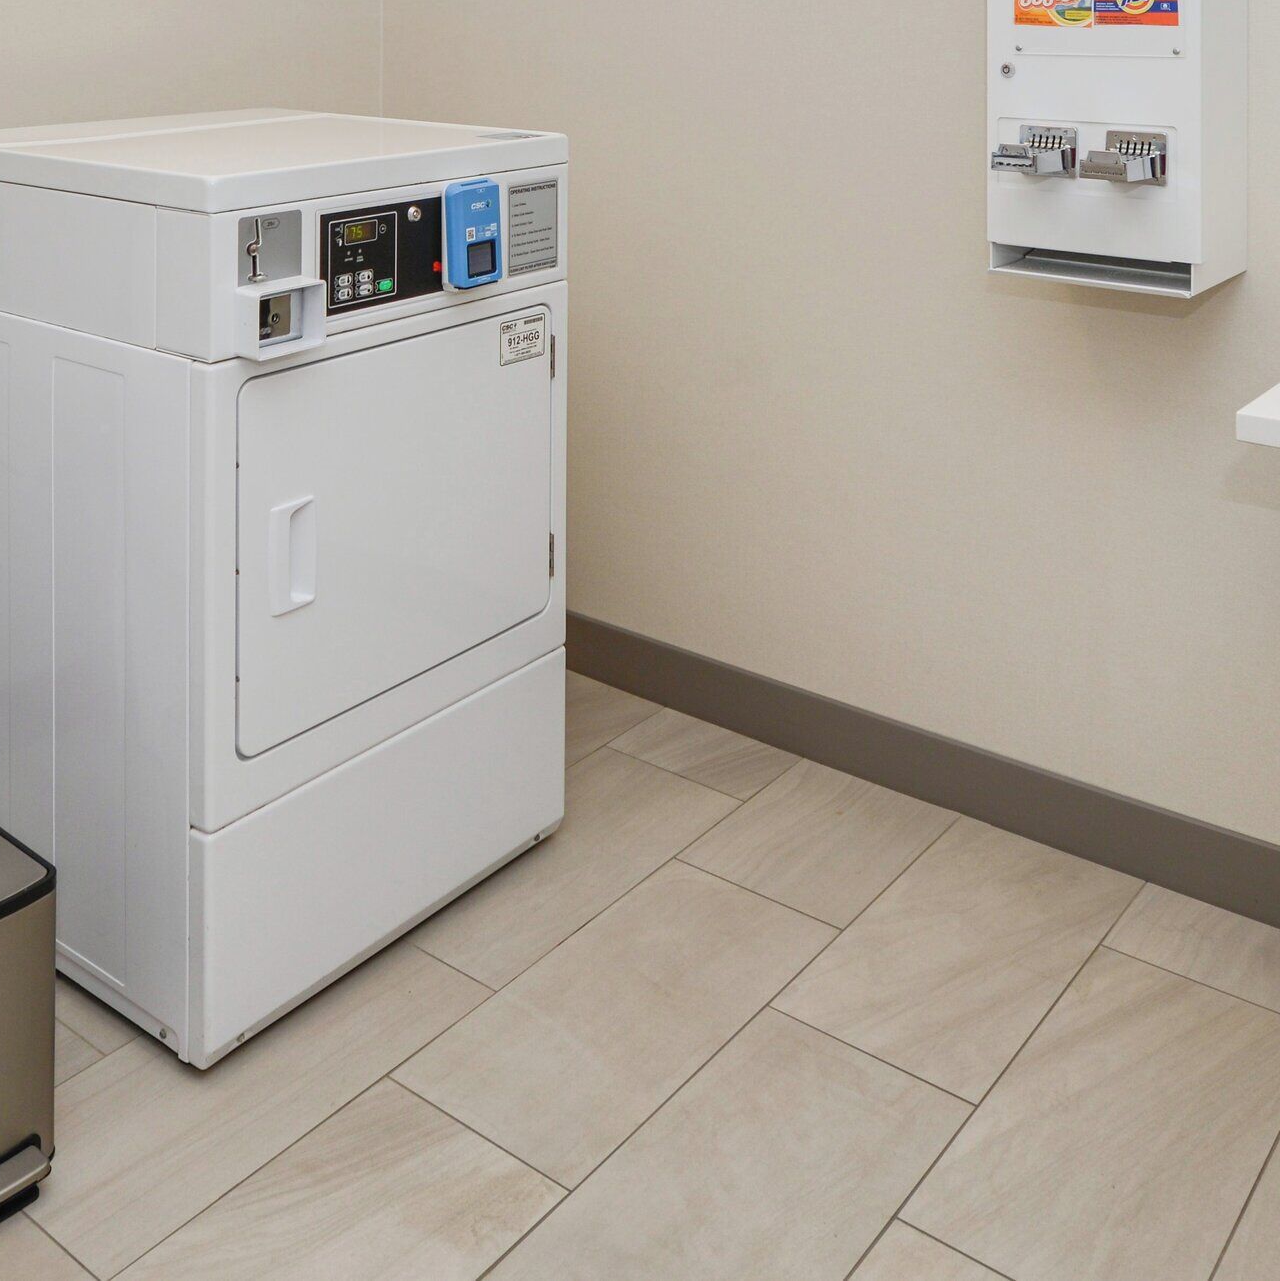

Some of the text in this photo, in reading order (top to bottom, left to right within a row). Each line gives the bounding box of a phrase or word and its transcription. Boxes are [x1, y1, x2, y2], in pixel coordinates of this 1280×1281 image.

[510, 182, 556, 196] OPERATING INSTRUCTIONS
[471, 201, 485, 210] CSC
[502, 323, 513, 332] CSC
[507, 330, 540, 347] 912-HGG
